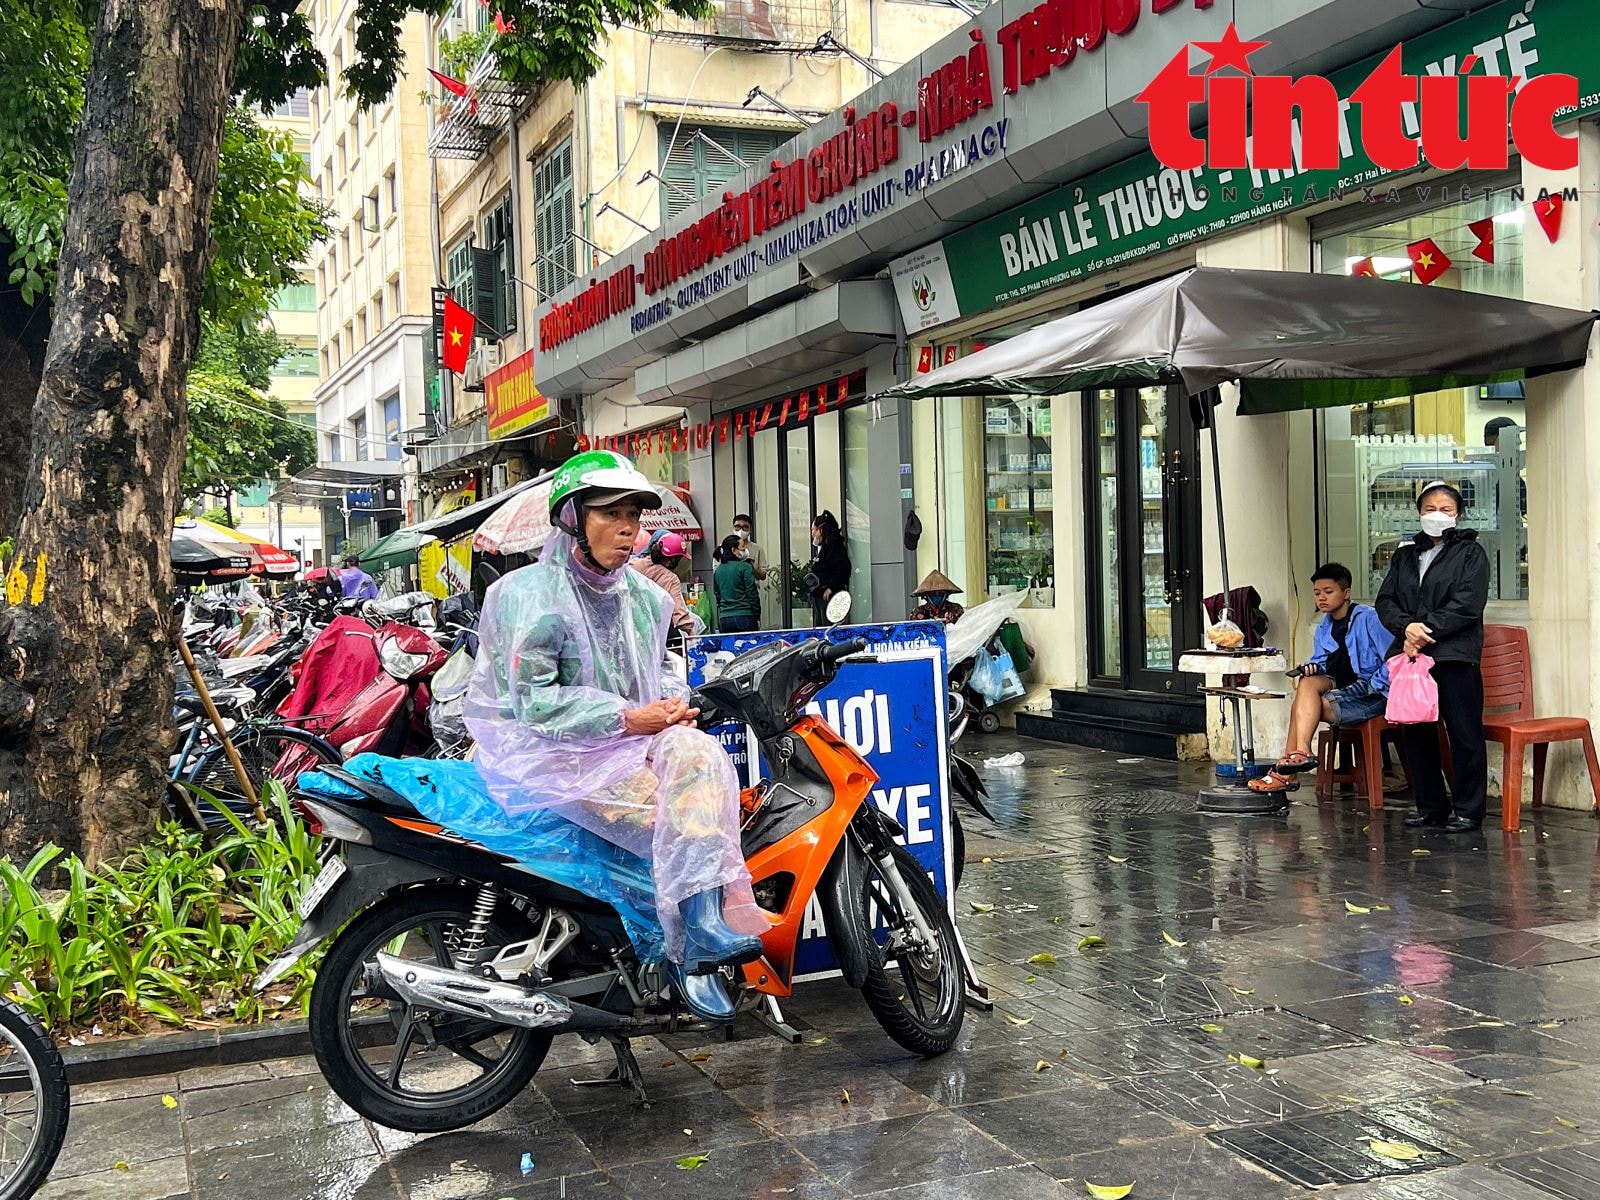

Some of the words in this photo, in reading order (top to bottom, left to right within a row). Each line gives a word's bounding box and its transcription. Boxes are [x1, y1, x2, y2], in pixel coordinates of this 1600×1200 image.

[1354, 172, 1363, 184] 37
[1365, 167, 1379, 180] Hai
[1580, 92, 1600, 109] 533
[572, 278, 610, 334] KHÁM
[609, 264, 636, 316] NHI
[750, 160, 805, 236] TIÊM
[807, 101, 899, 204] CHỦNG
[918, 28, 993, 143] NHÀ
[630, 297, 672, 334] PEDIATRIC
[677, 264, 731, 309] OUTPATIENT
[733, 250, 758, 281] UNIT
[765, 198, 858, 266] IMMUNIZATION
[861, 178, 895, 217] UNIT
[904, 117, 1009, 196] PHARMACY
[1000, 217, 1059, 277] BÁN
[1059, 187, 1098, 256] LẺ
[1099, 160, 1208, 240] THUỐC
[1167, 232, 1180, 246] GIỜ
[1180, 228, 1197, 241] PHỤC
[1230, 210, 1251, 224] 22H00
[1250, 203, 1271, 218] HÀNG
[1272, 196, 1293, 210] NGÀY
[1087, 259, 1096, 271] SỐ
[640, 520, 664, 528] SINH
[664, 517, 689, 528] VIÊN
[874, 639, 902, 654] HOÀN
[903, 636, 930, 650] KIẾM
[872, 783, 934, 847] XE
